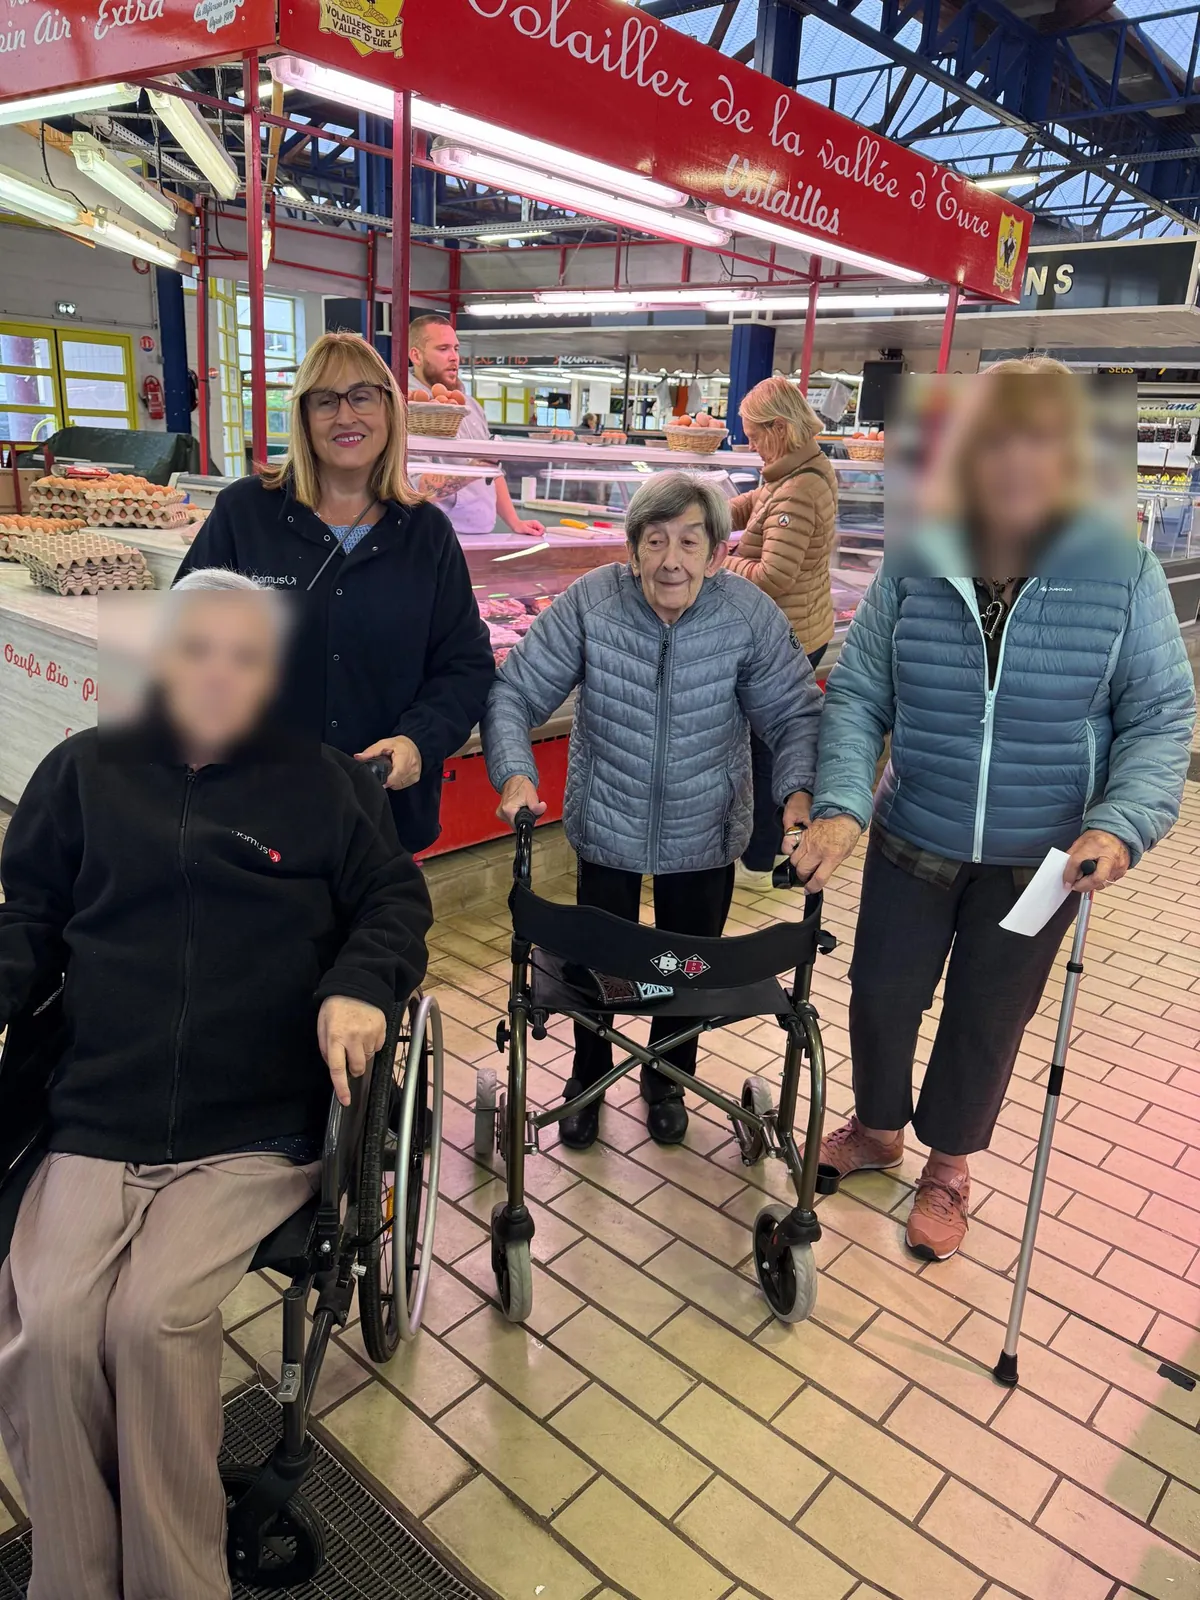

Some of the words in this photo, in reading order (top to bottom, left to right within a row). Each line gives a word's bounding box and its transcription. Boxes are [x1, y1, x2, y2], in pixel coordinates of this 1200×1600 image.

[34, 10, 72, 45] Air
[93, 0, 164, 41] Extra
[332, 19, 361, 37] VALLEE
[364, 33, 392, 48] D'EURE
[375, 28, 386, 38] DE
[388, 29, 398, 38] LA
[469, 0, 693, 107] olailler
[710, 74, 754, 134] de
[768, 94, 804, 157] la
[816, 135, 900, 199] vallée
[909, 165, 991, 238] d'Eure
[722, 153, 840, 236] Volailles
[4, 643, 42, 678] Oeufs
[46, 660, 69, 688] Bio
